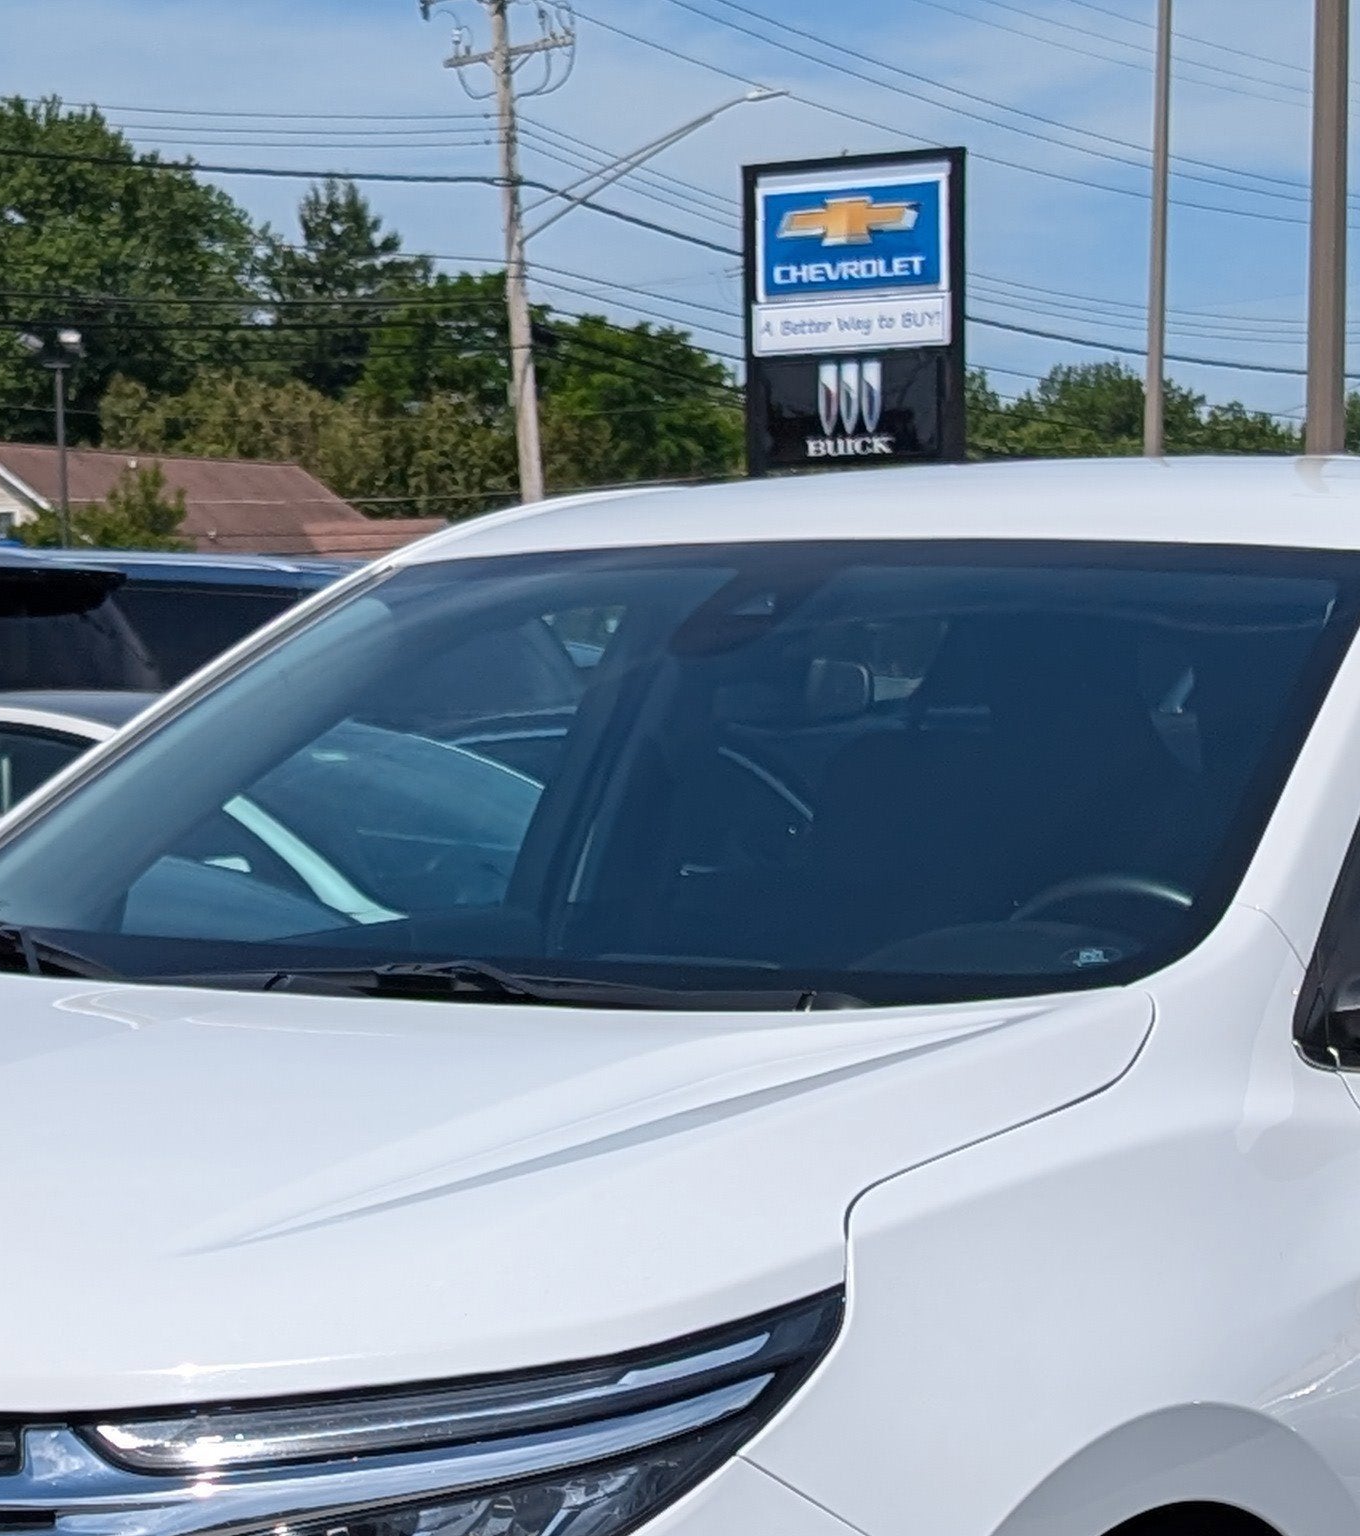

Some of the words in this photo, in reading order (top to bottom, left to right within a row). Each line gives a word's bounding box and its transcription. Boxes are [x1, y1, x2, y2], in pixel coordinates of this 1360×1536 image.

[773, 255, 926, 285] CHEVROLET
[760, 320, 773, 337] A
[780, 320, 832, 336] Better
[837, 317, 872, 335] Way
[877, 314, 896, 330] to
[805, 435, 896, 457] BUICK
